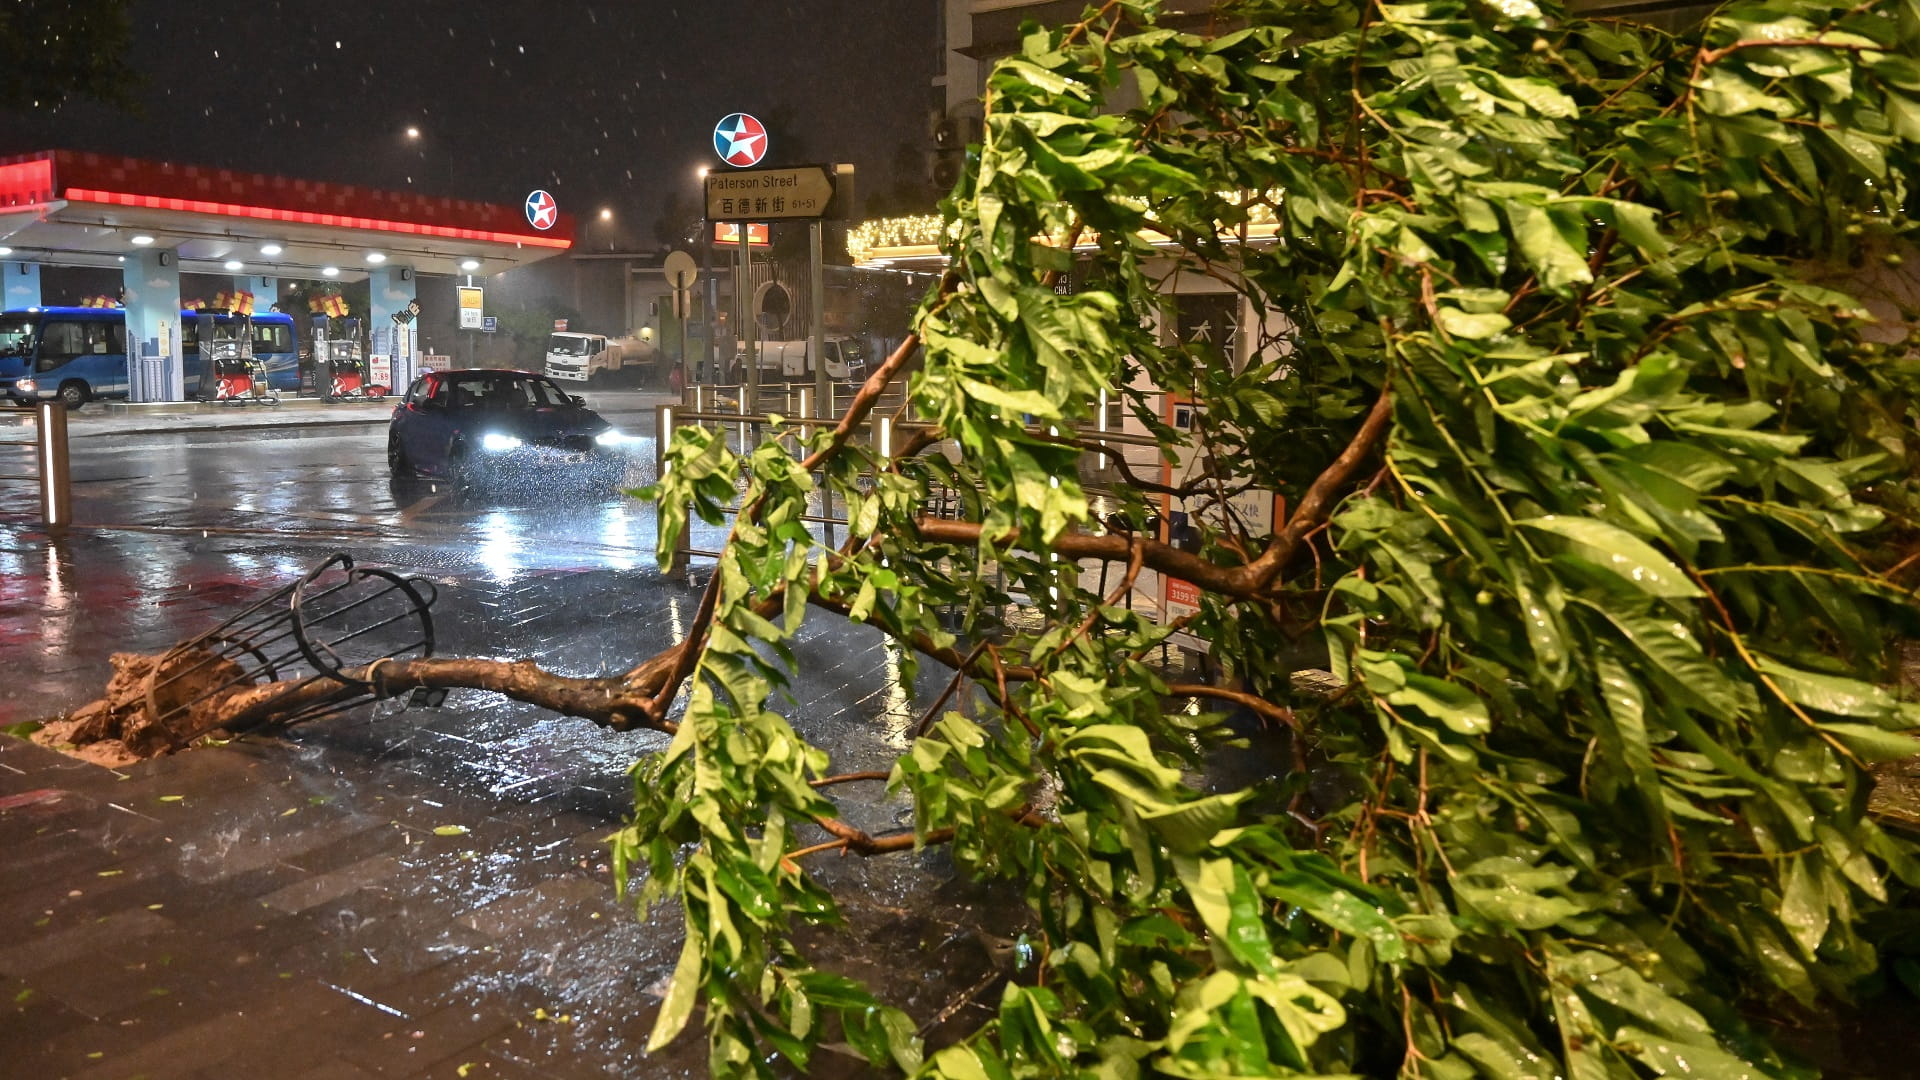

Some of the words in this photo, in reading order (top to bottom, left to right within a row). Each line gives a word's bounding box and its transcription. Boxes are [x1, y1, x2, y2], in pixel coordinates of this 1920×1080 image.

[710, 177, 759, 190] Paterson
[762, 174, 798, 188] Street
[722, 197, 785, 214] 百德新街
[1054, 285, 1068, 295] CHA
[1171, 589, 1189, 601] 3199
